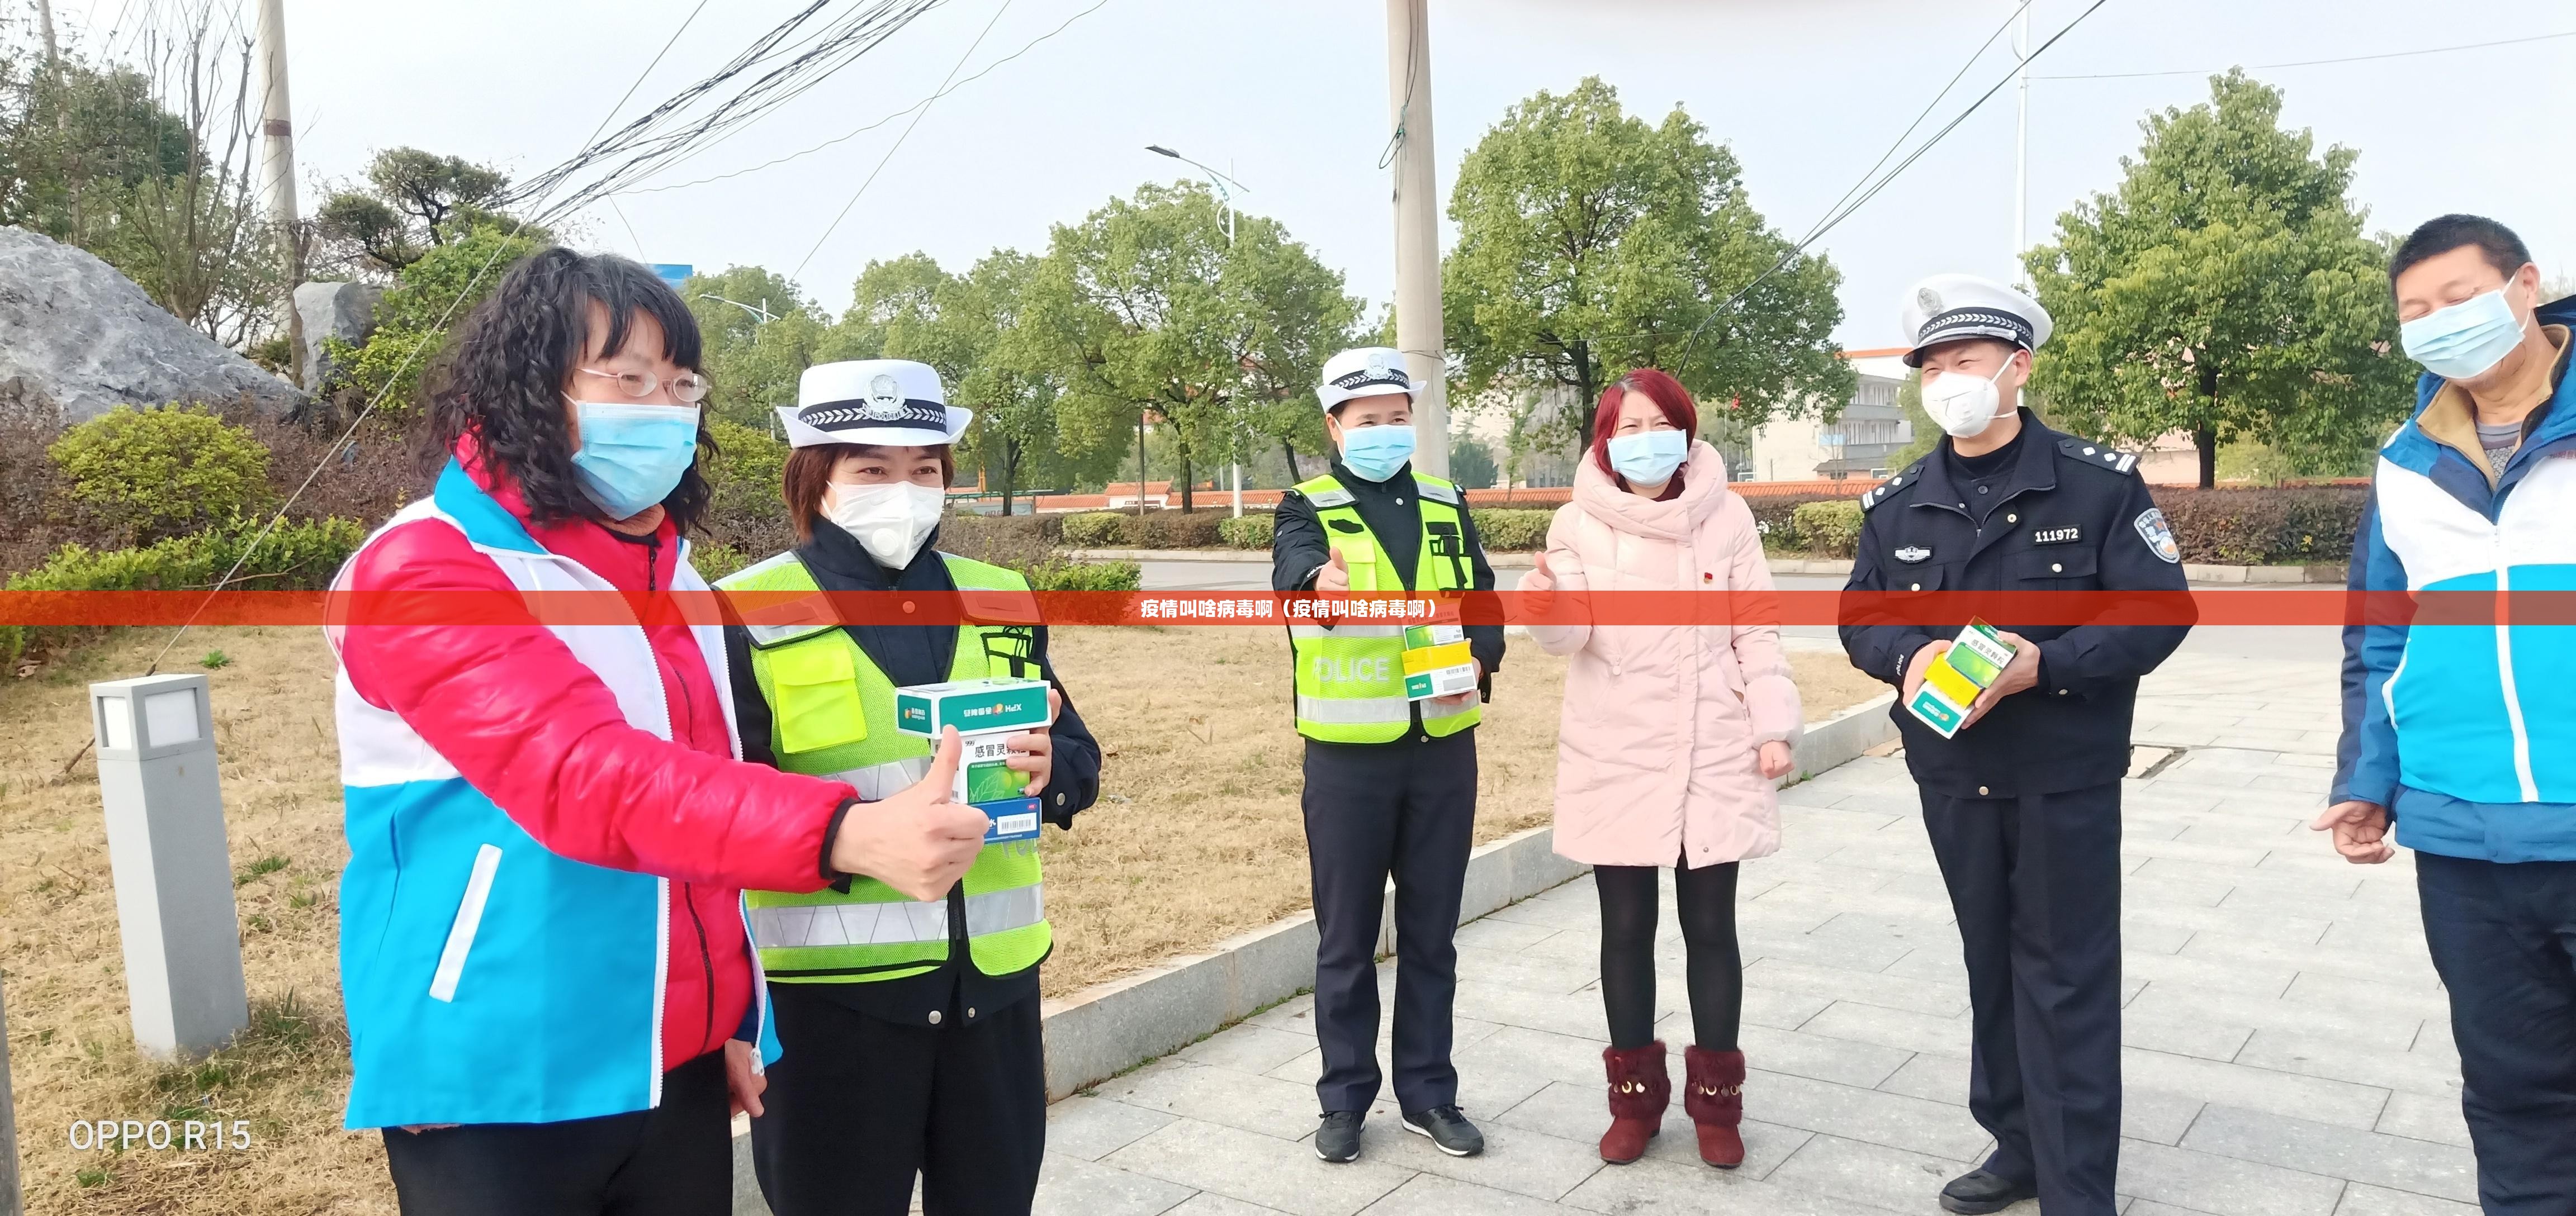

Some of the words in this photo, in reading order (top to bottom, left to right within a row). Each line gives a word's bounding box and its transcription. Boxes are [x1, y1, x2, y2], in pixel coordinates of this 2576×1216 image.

[2035, 528, 2078, 542] 111972
[975, 744, 1026, 758] 感冒灵
